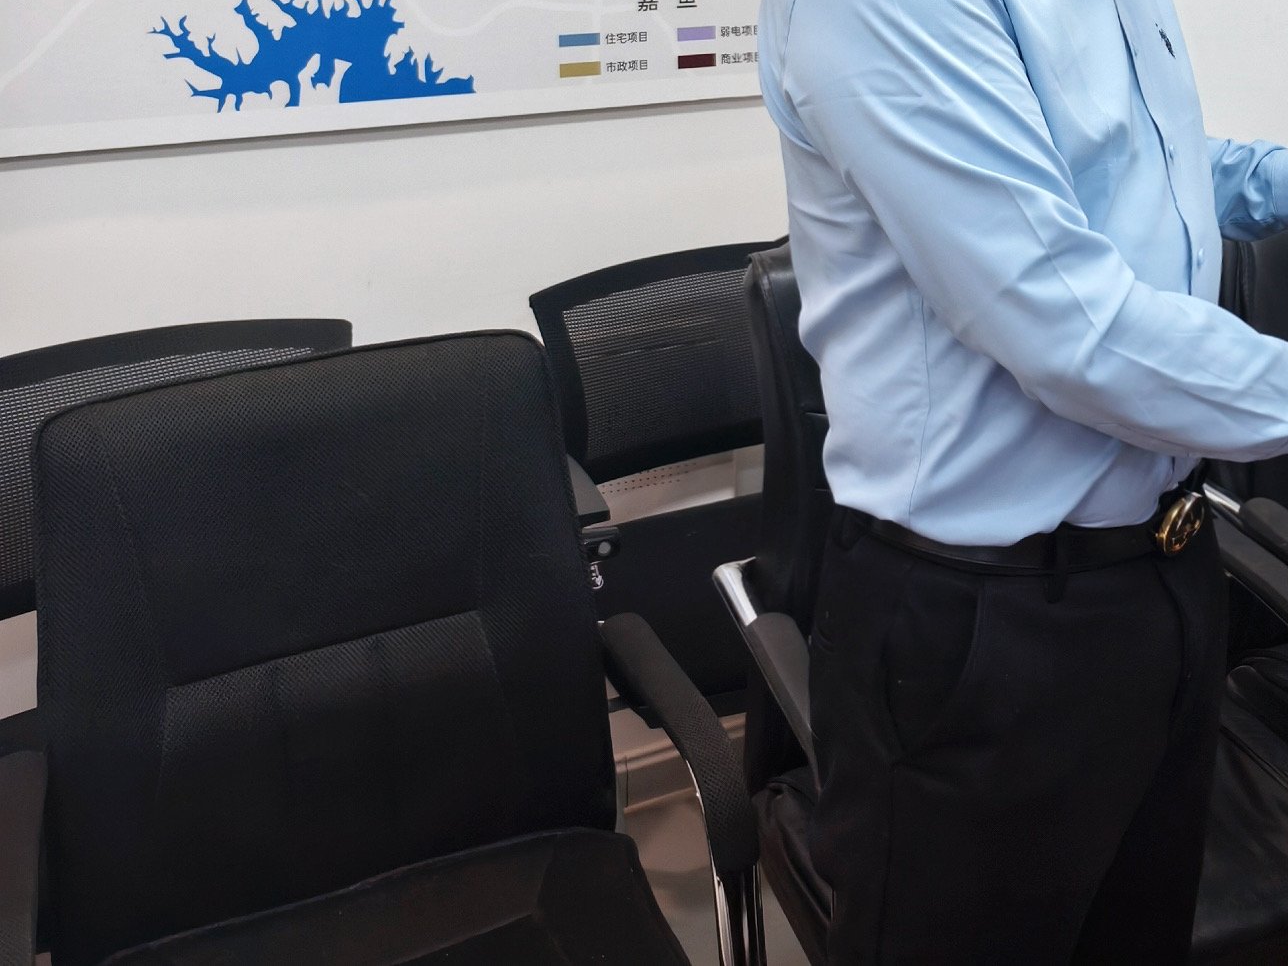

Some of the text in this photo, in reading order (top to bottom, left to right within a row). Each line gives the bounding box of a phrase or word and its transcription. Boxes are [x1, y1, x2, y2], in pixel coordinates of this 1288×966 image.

[605, 31, 648, 45] 住宅项目
[606, 59, 648, 73] 市政项目
